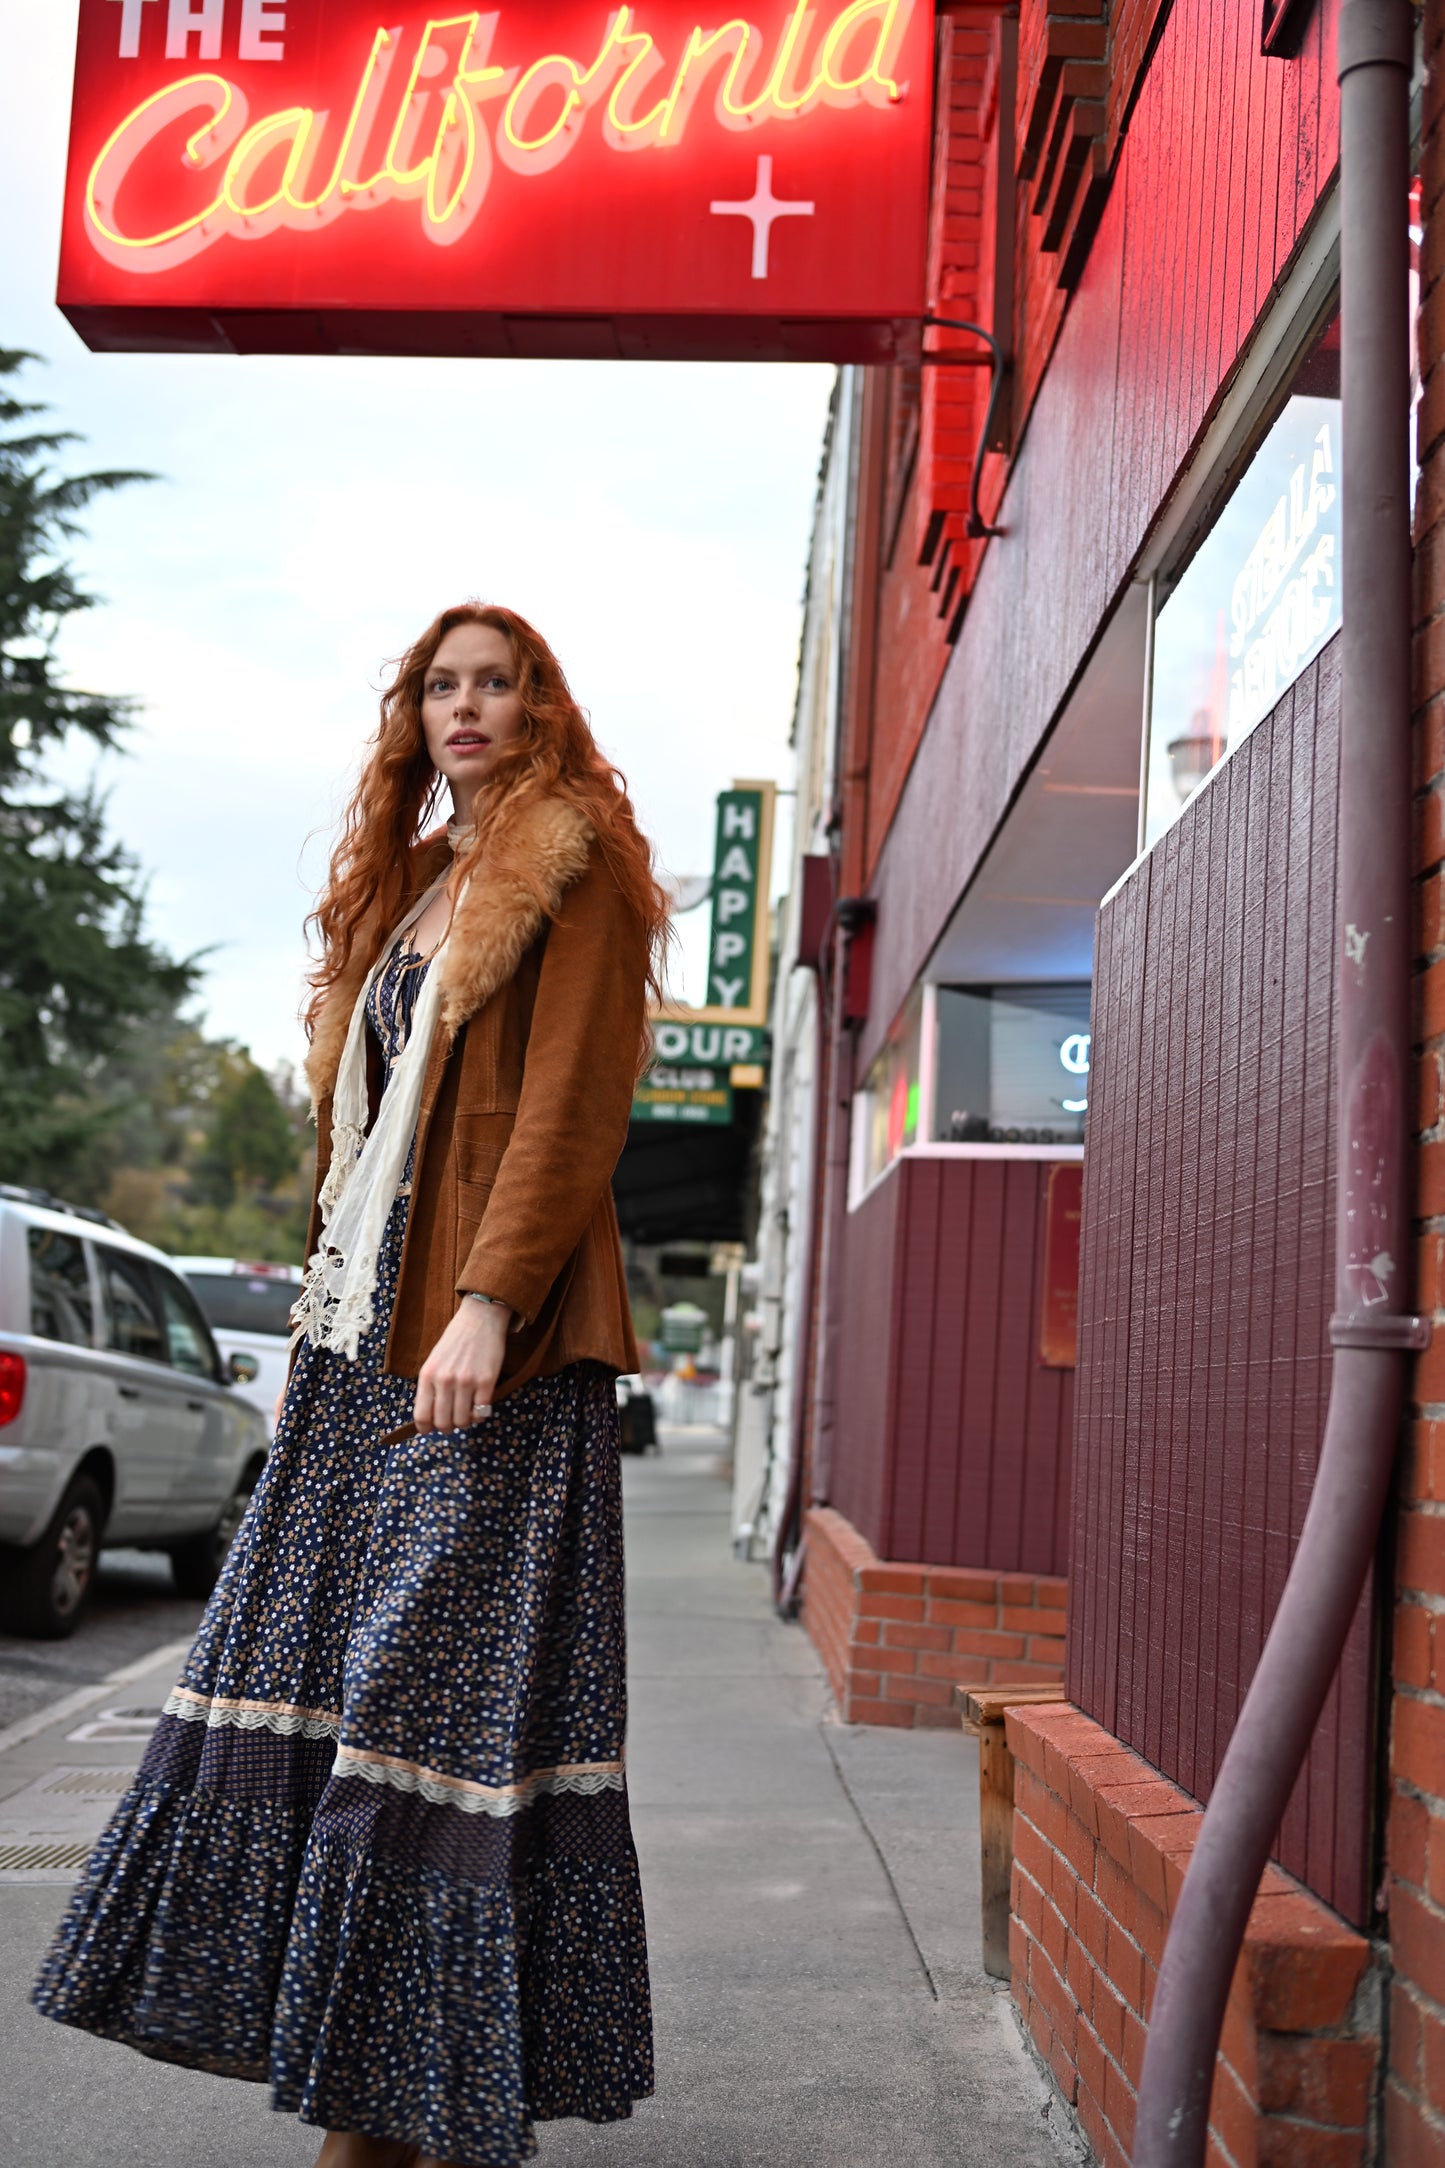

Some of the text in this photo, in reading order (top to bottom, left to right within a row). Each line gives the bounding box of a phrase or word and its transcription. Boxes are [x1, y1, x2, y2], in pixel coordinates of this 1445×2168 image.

[96, 0, 287, 61] THE
[83, 0, 911, 273] California
[712, 804, 755, 1009] HAPPY
[655, 1024, 753, 1062] OUR
